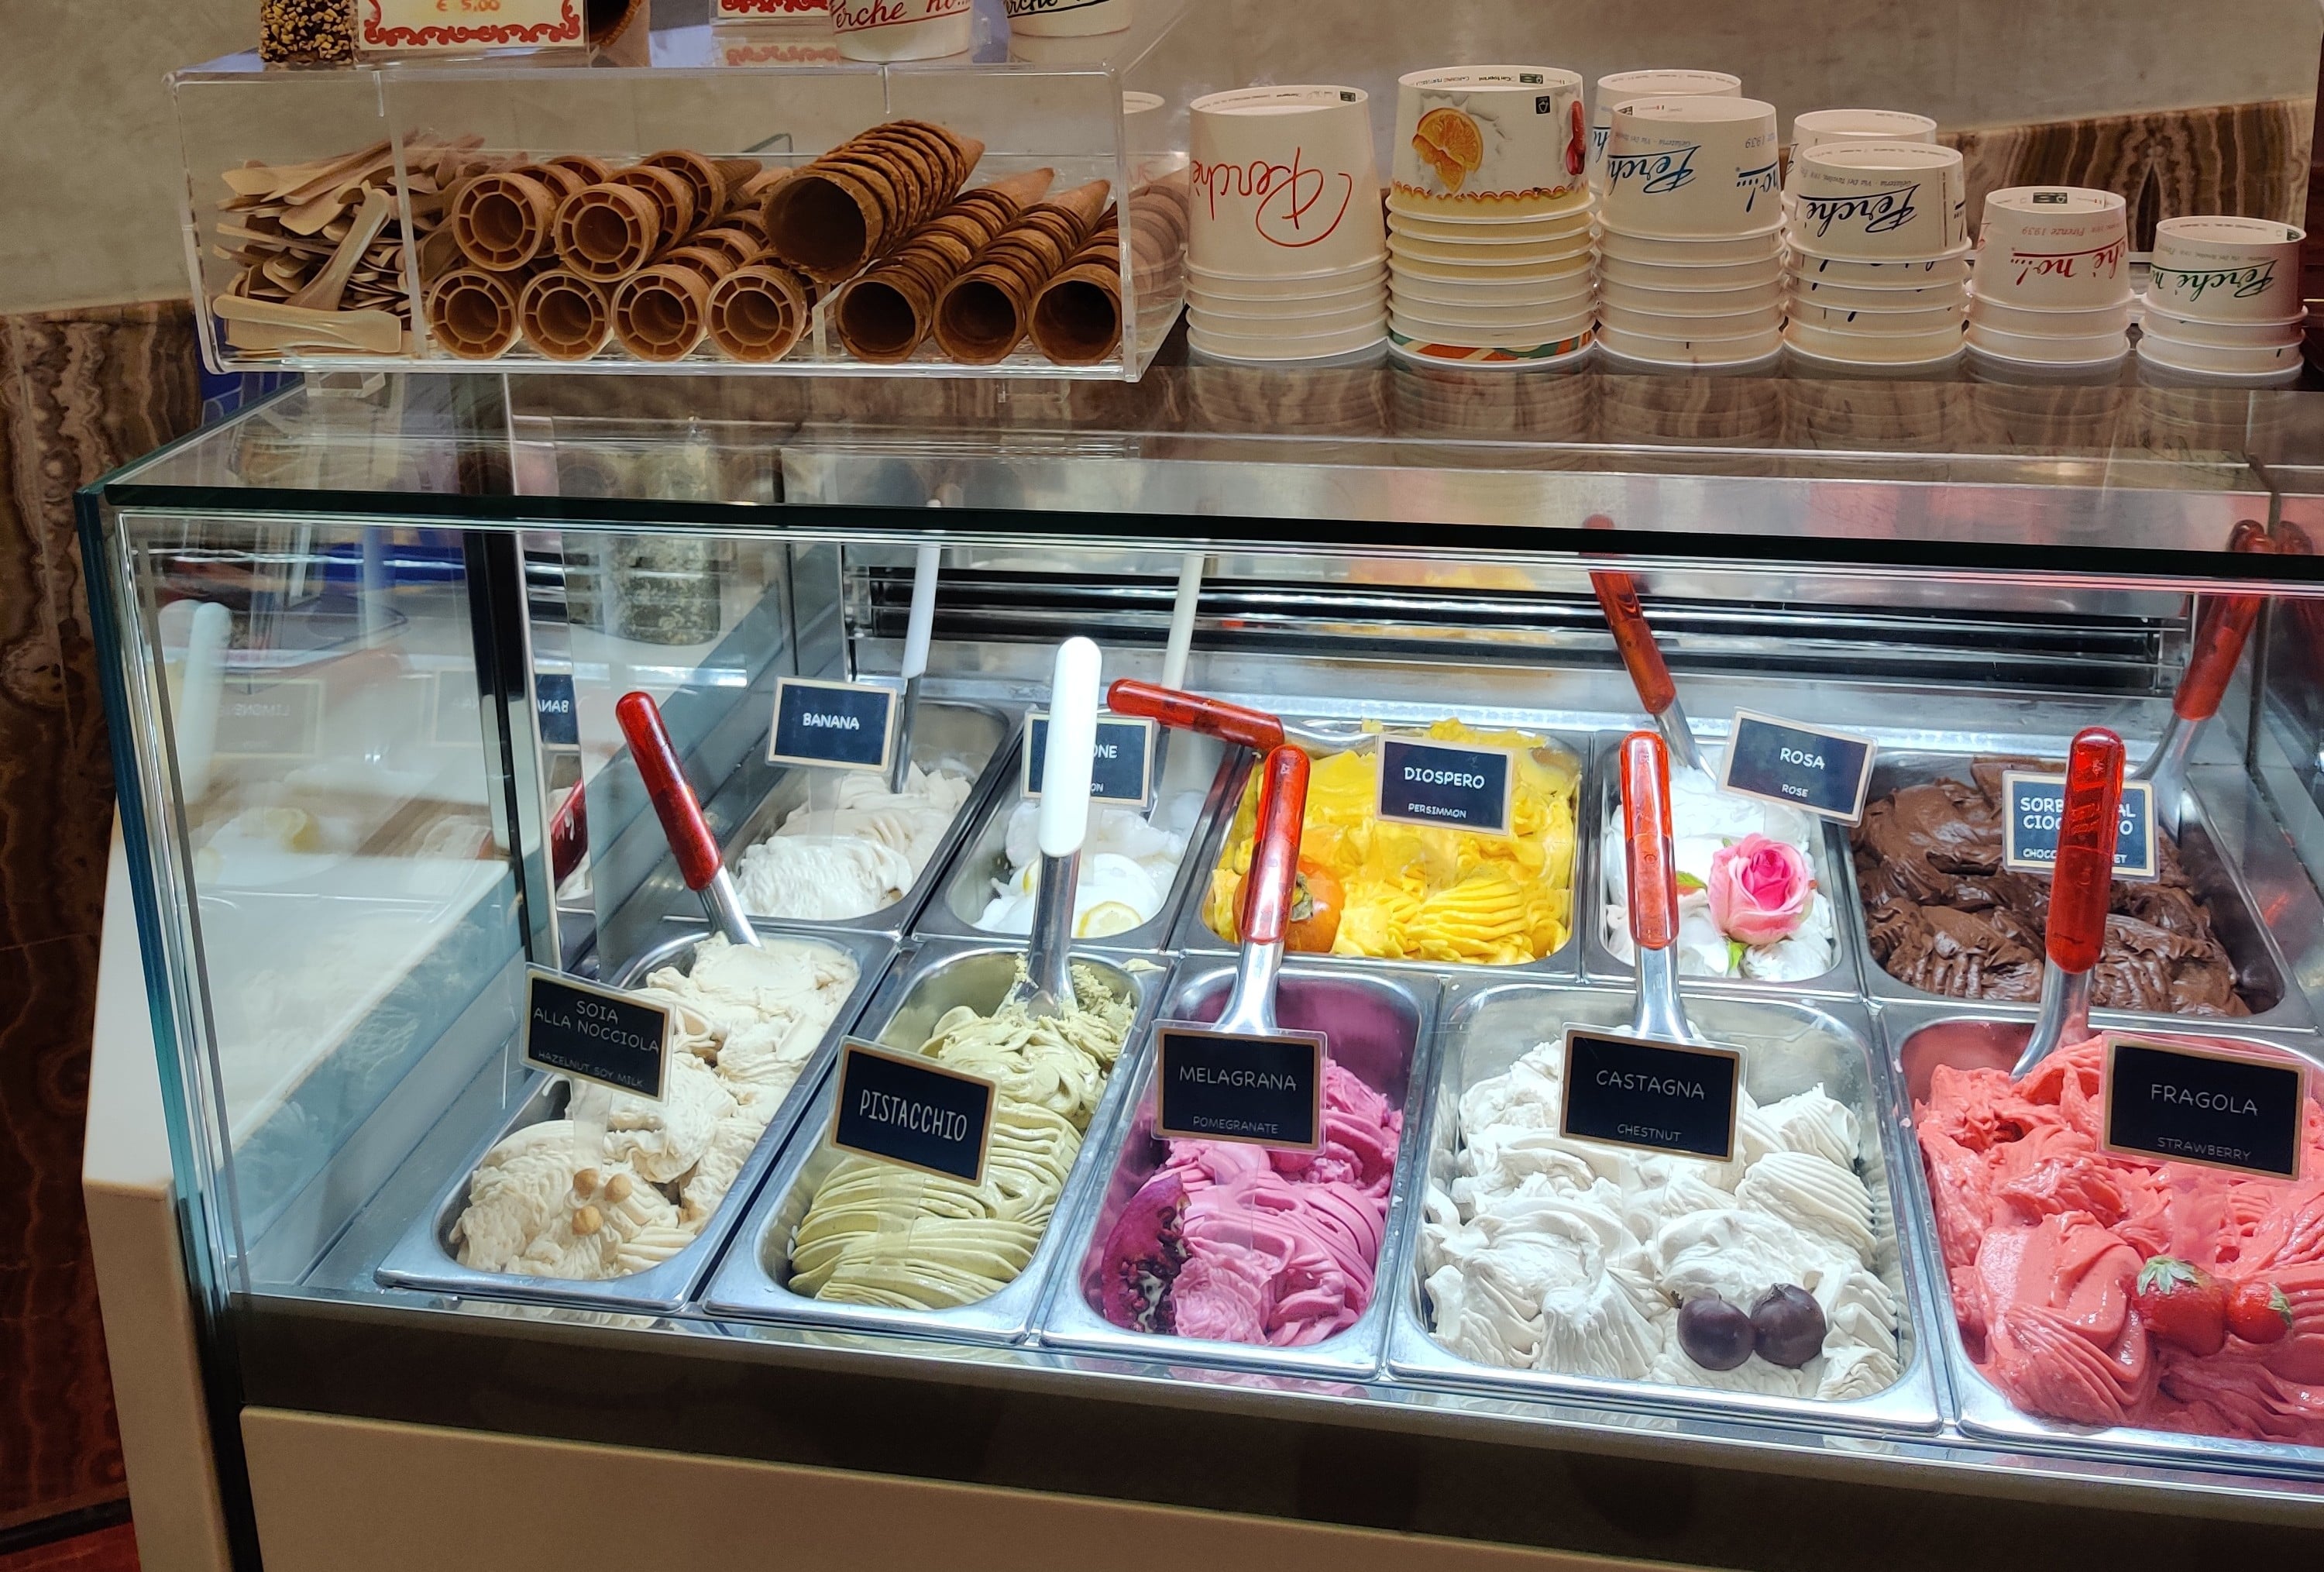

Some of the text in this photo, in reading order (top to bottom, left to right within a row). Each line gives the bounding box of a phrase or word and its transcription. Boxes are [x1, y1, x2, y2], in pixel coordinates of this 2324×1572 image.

[802, 712, 860, 731] BANANA
[1779, 747, 1826, 770] ROSA
[1404, 766, 1486, 790] DIOSPERO
[1781, 783, 1810, 798] ROSE
[1408, 802, 1467, 819] PERSIMMON
[576, 1000, 619, 1025] SOIA
[533, 1007, 660, 1054] ALLA NOCCIOLA
[538, 1050, 645, 1088] HAZELNUT SOY MILK
[1179, 1065, 1298, 1092] MELAGRANA
[1595, 1069, 1705, 1101] CASTAGNA
[2150, 1084, 2259, 1116] FRAGOLA
[859, 1089, 968, 1142] PISTACCHIO
[1192, 1116, 1279, 1134] POMEGRANATE
[1617, 1123, 1683, 1142] CHESTNUT
[2157, 1137, 2252, 1161] STRAWBERRY
